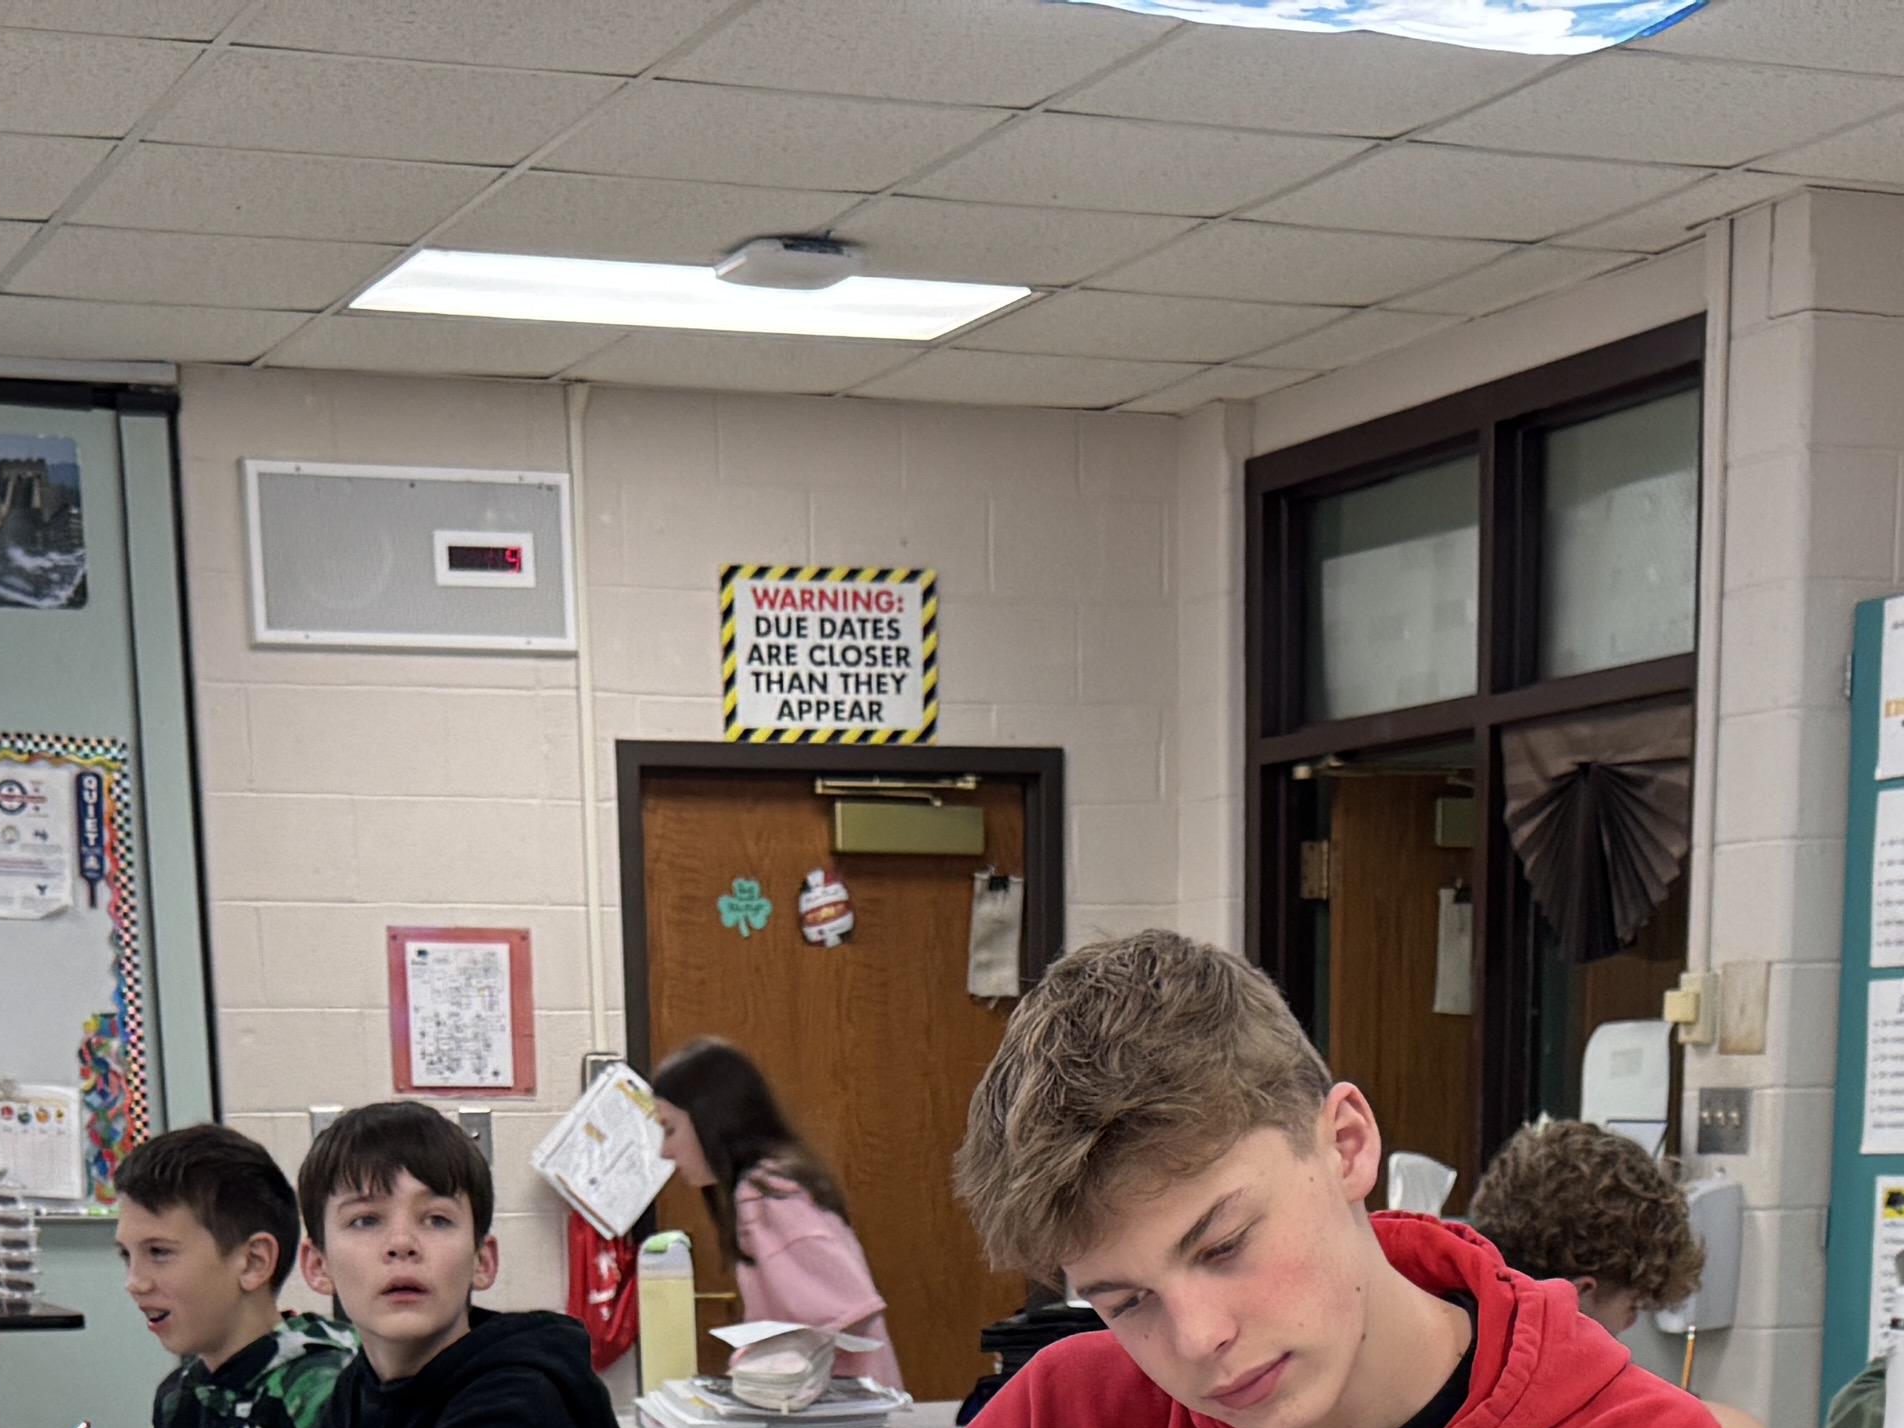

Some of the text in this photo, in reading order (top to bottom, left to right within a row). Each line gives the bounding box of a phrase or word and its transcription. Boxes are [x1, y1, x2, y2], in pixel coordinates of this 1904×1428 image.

[751, 587, 905, 614] WARNING:
[754, 615, 902, 640] DUE DATES
[747, 644, 912, 668] ARE CLOSER
[751, 671, 908, 695] THAN THEY
[776, 699, 884, 723] APPEAR
[82, 776, 99, 847] QUIET
